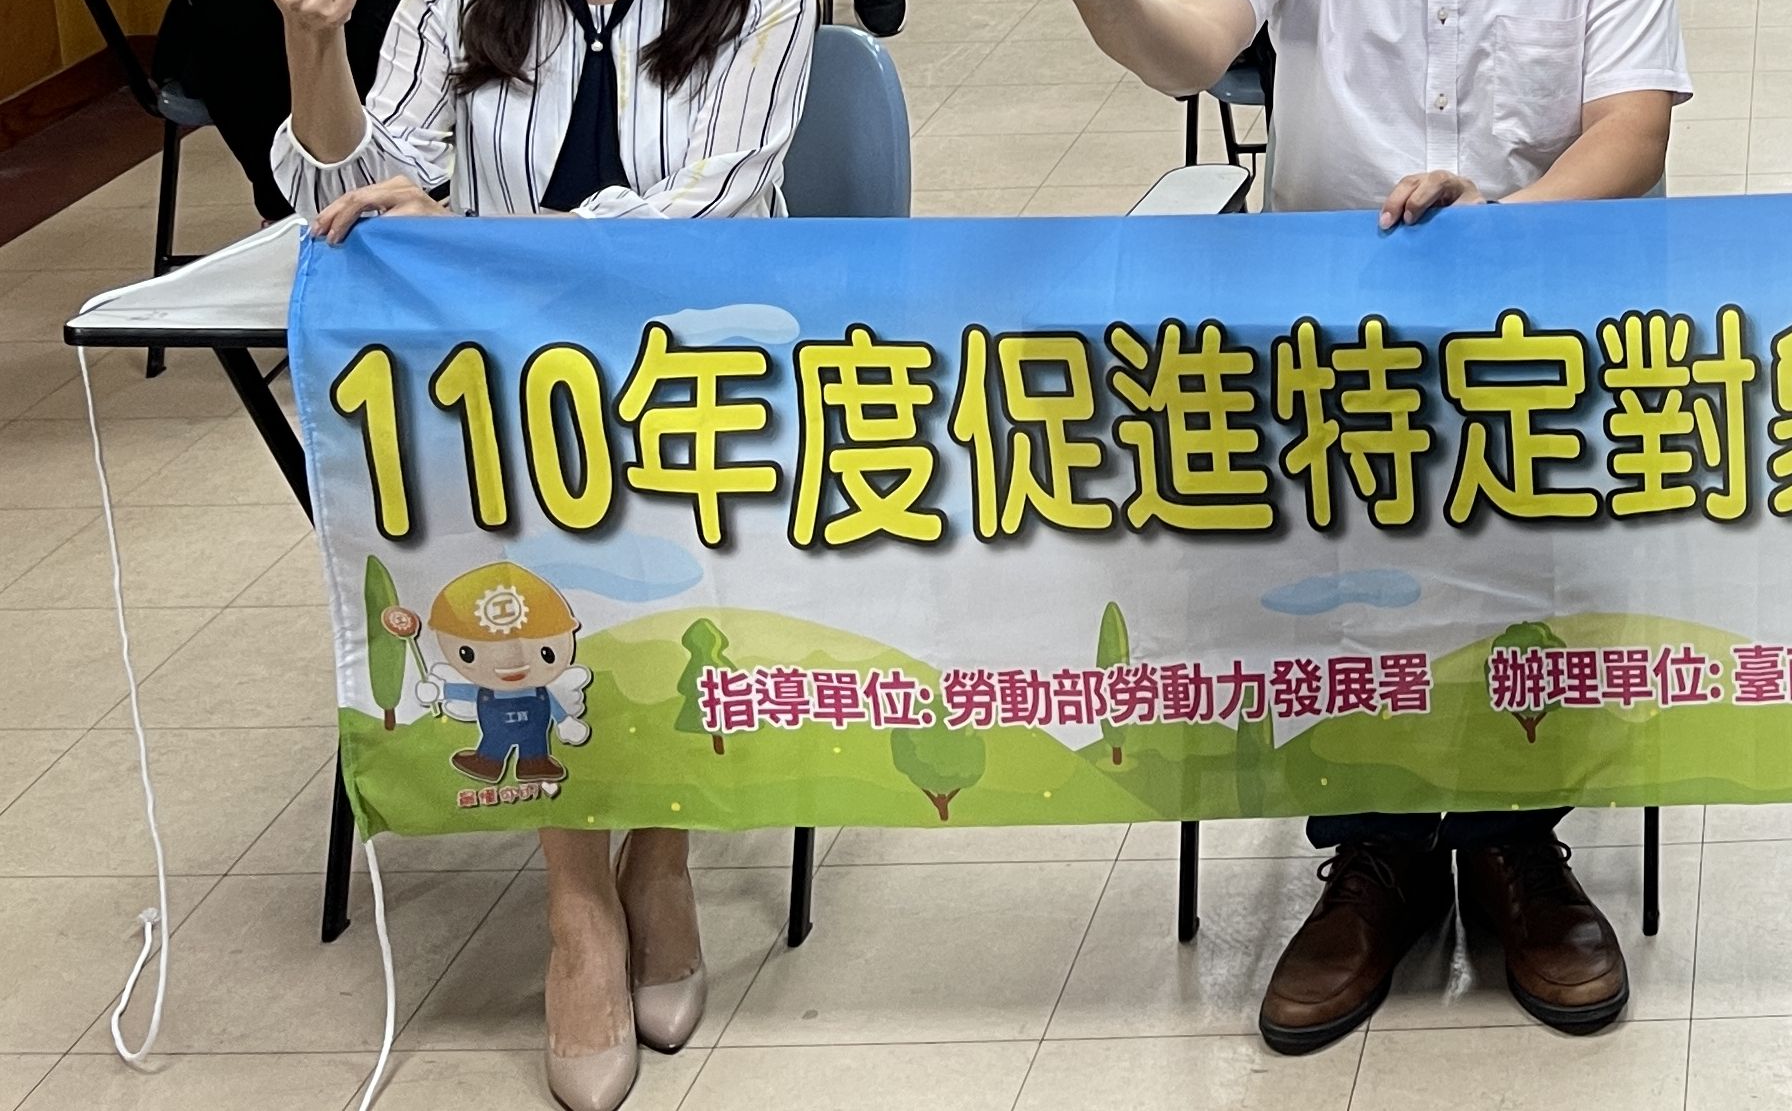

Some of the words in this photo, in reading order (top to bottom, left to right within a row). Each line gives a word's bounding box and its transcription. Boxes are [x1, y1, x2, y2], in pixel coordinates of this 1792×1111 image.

[700, 664, 934, 733] 指導單位:
[944, 652, 1431, 730] 勞動部勞動力發展署
[1490, 644, 1724, 710] 辦理單位:
